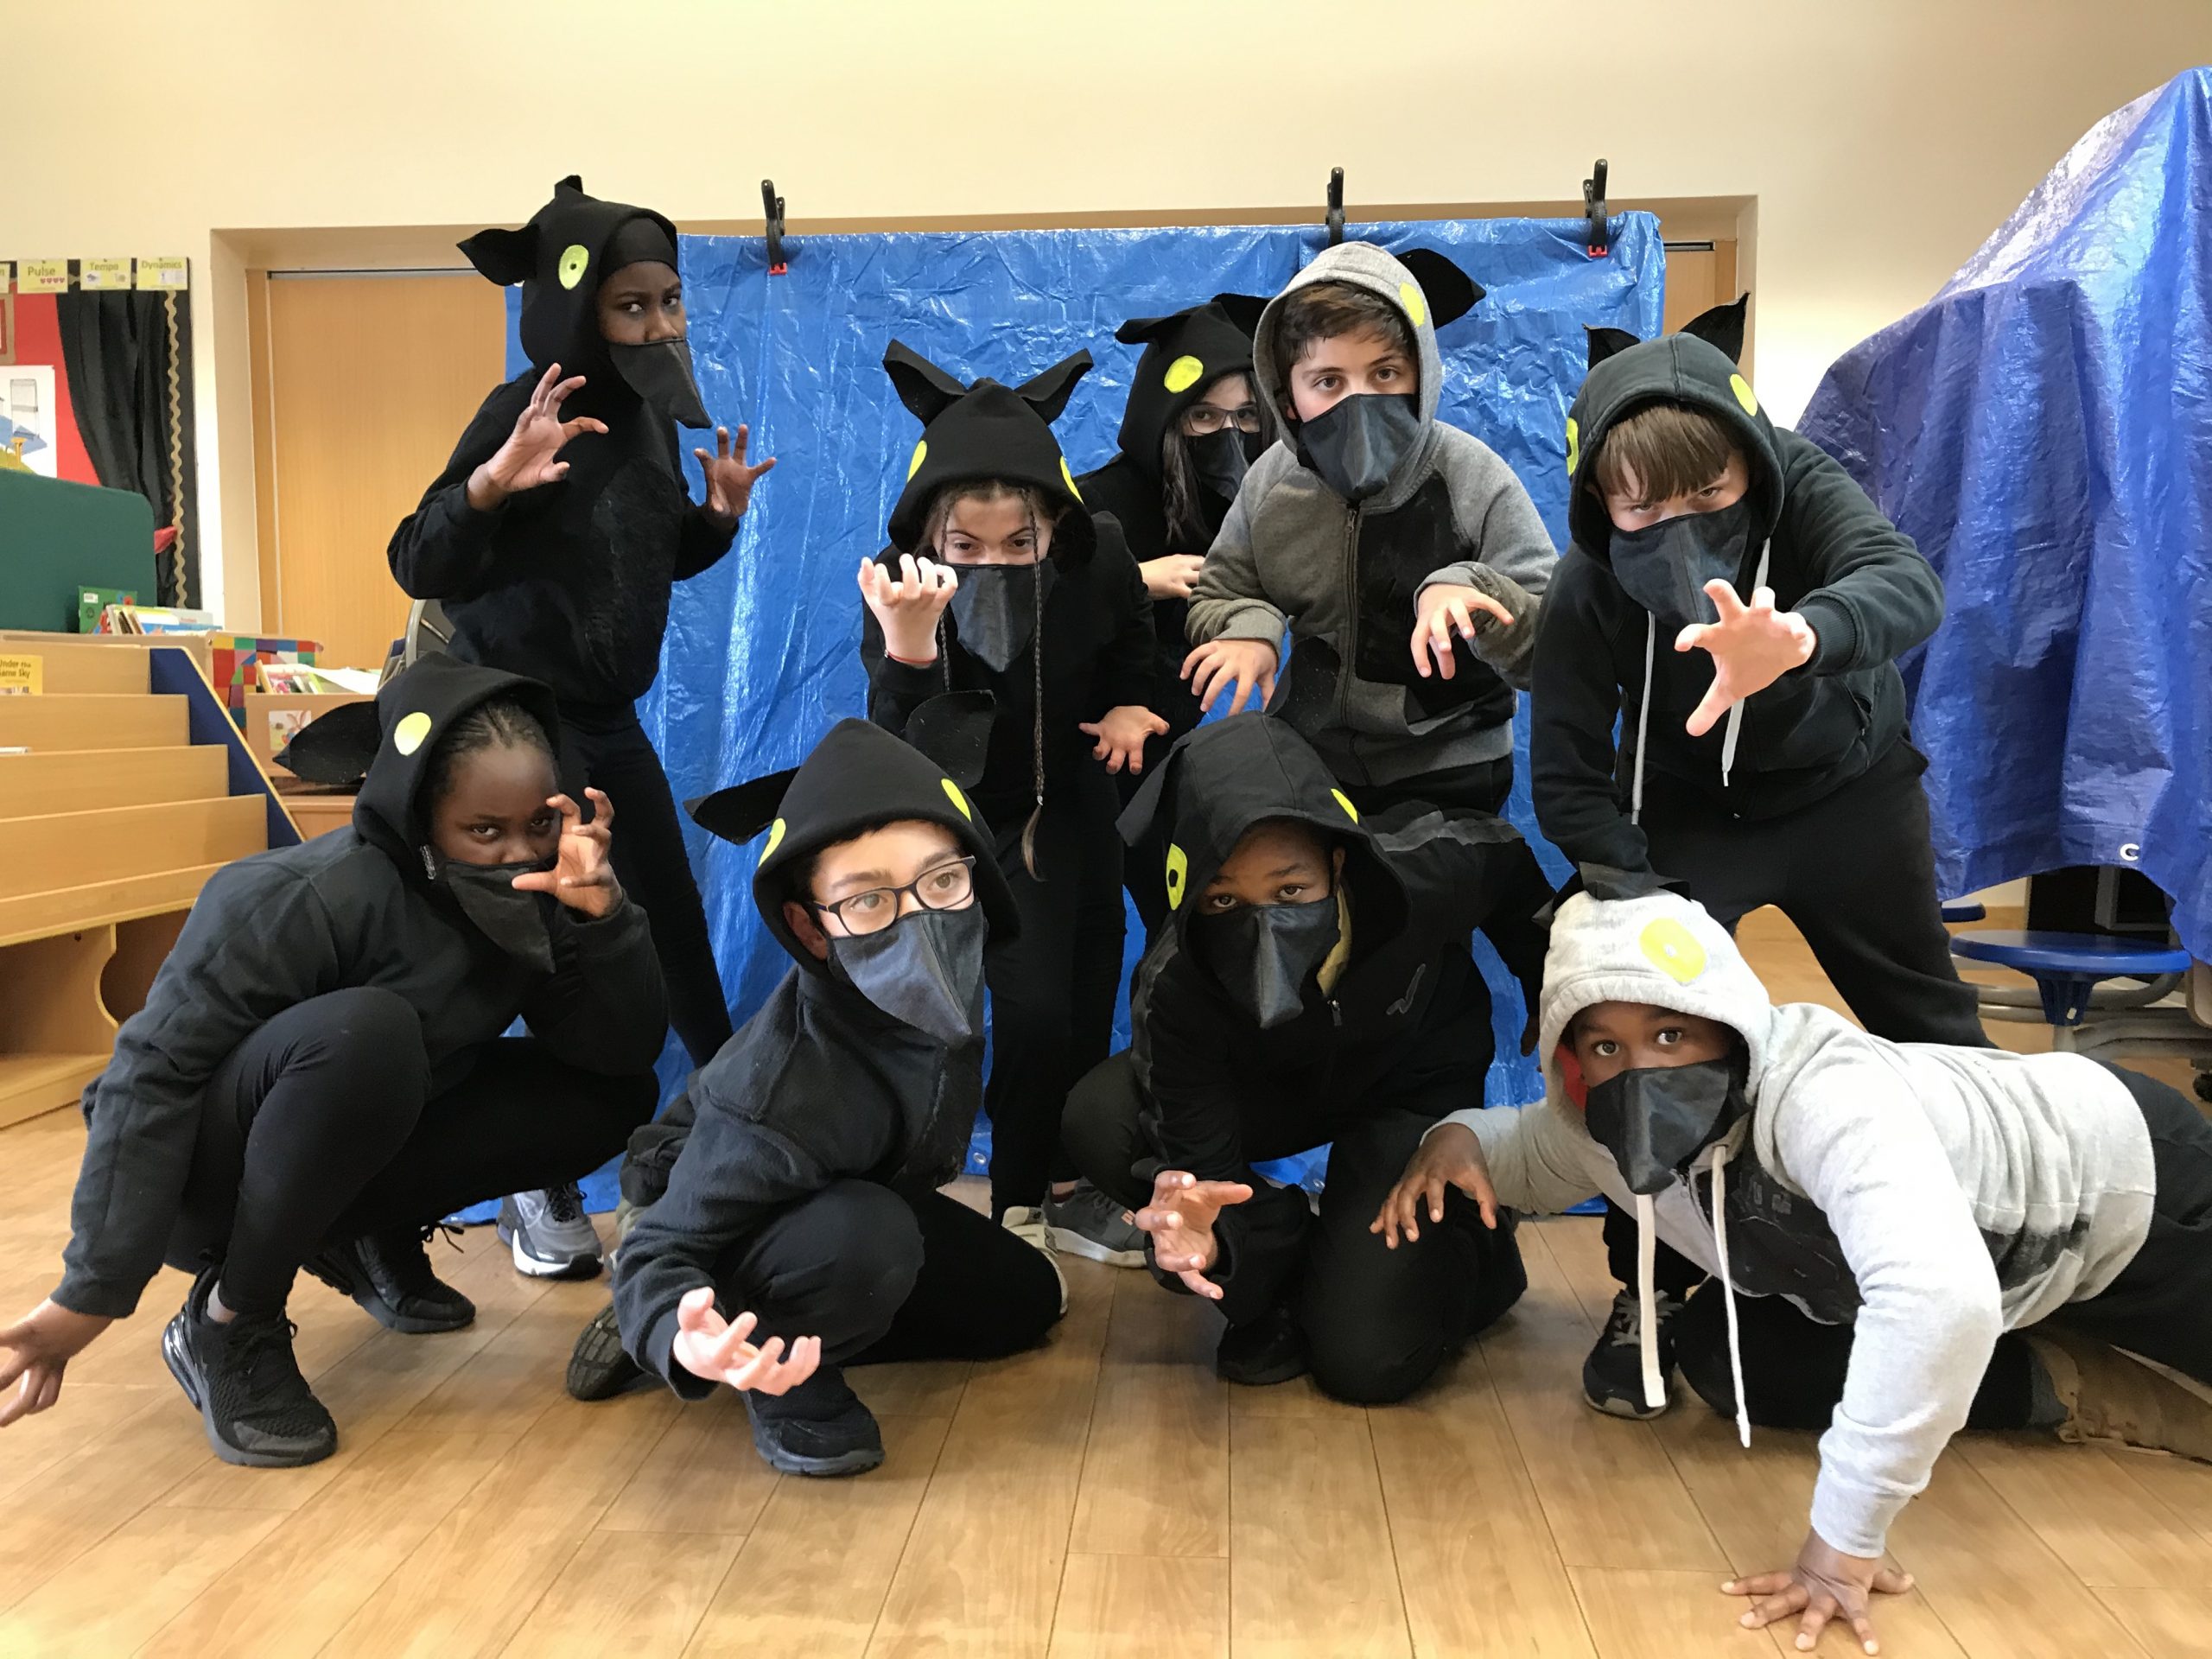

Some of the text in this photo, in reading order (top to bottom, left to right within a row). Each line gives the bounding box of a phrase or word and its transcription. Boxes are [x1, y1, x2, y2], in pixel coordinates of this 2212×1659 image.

[90, 262, 118, 271] Tempo
[142, 260, 182, 270] Dynamics
[27, 265, 55, 276] Pulse
